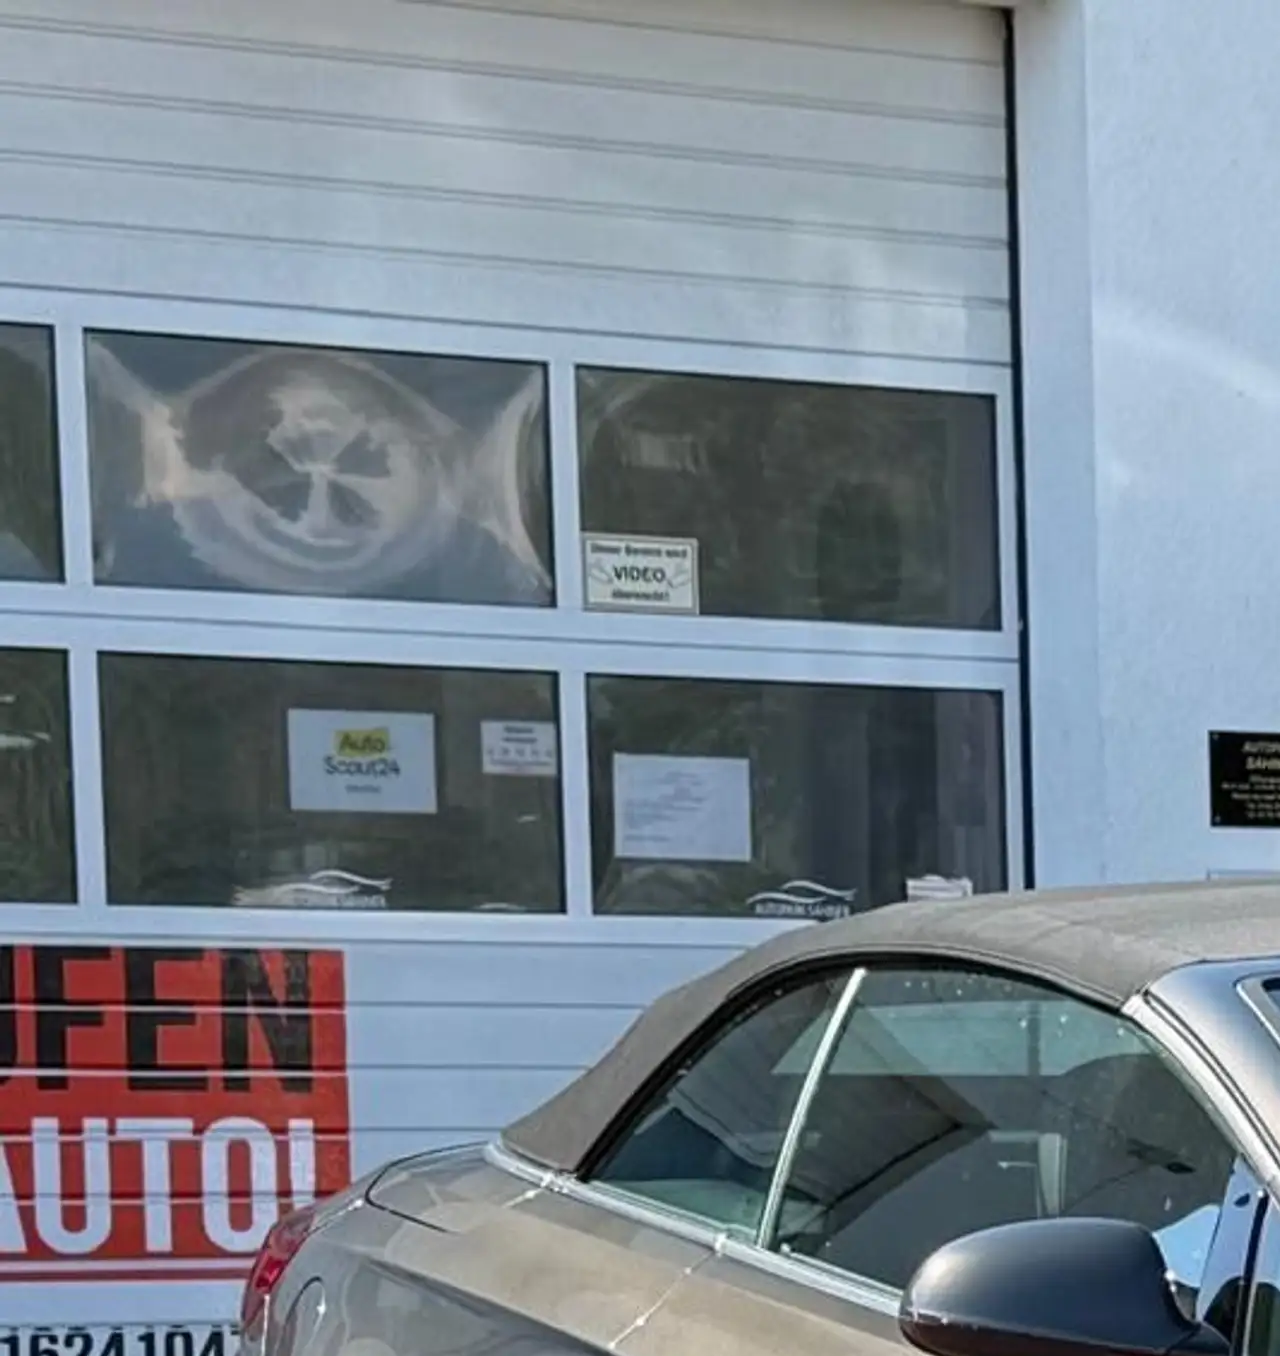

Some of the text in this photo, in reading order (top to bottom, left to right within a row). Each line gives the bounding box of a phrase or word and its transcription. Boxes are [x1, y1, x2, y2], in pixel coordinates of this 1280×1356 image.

[613, 565, 666, 583] VIDEO
[339, 734, 386, 753] Auto
[323, 756, 402, 779] Scout24
[0, 945, 315, 1093] FEN
